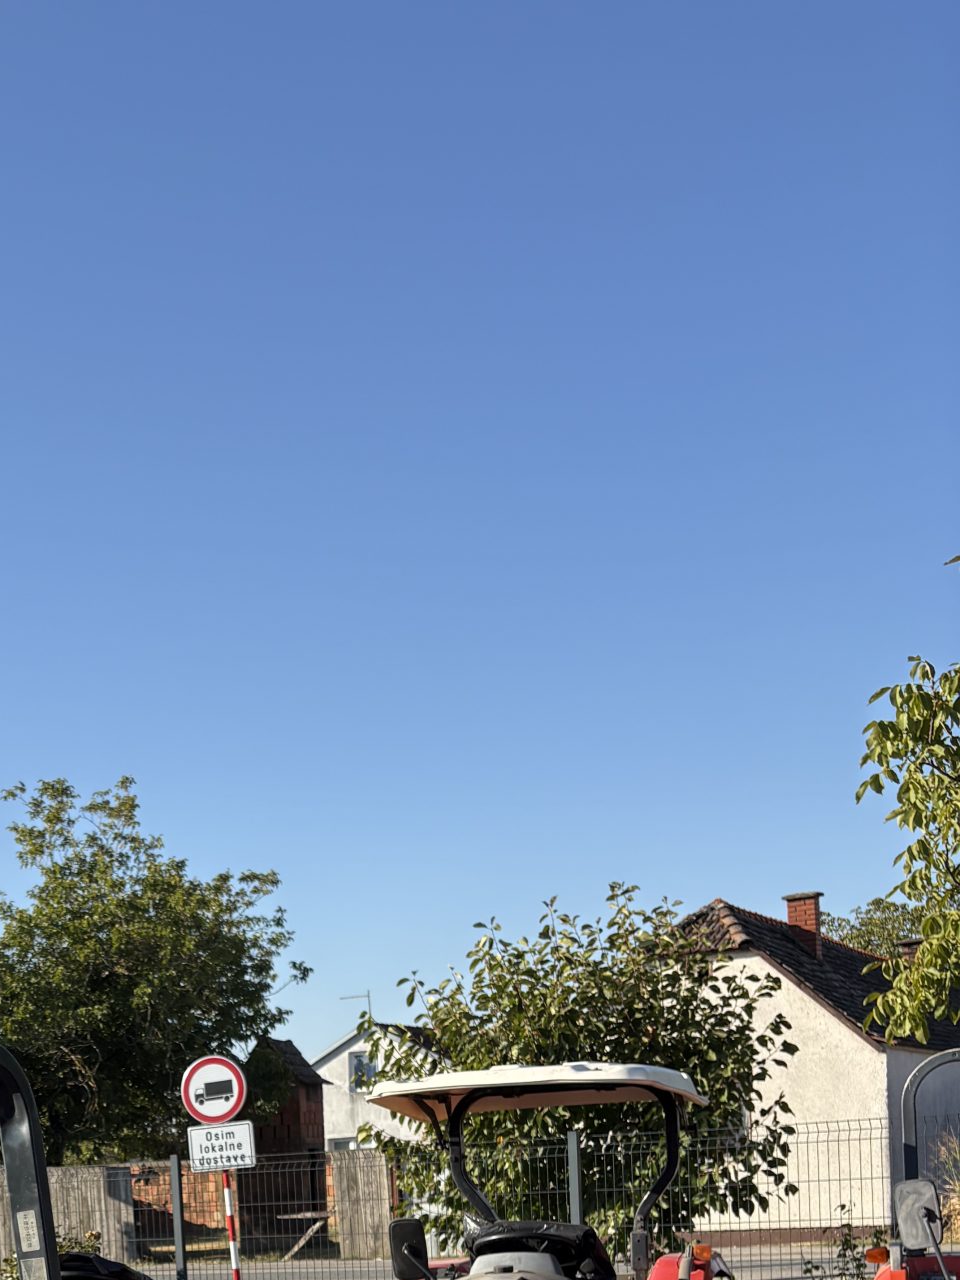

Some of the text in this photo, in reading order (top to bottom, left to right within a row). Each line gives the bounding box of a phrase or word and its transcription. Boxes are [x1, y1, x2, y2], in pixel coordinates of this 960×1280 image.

[205, 1131, 235, 1141] Osim
[199, 1142, 243, 1154] lokalne
[199, 1154, 246, 1166] dostave
